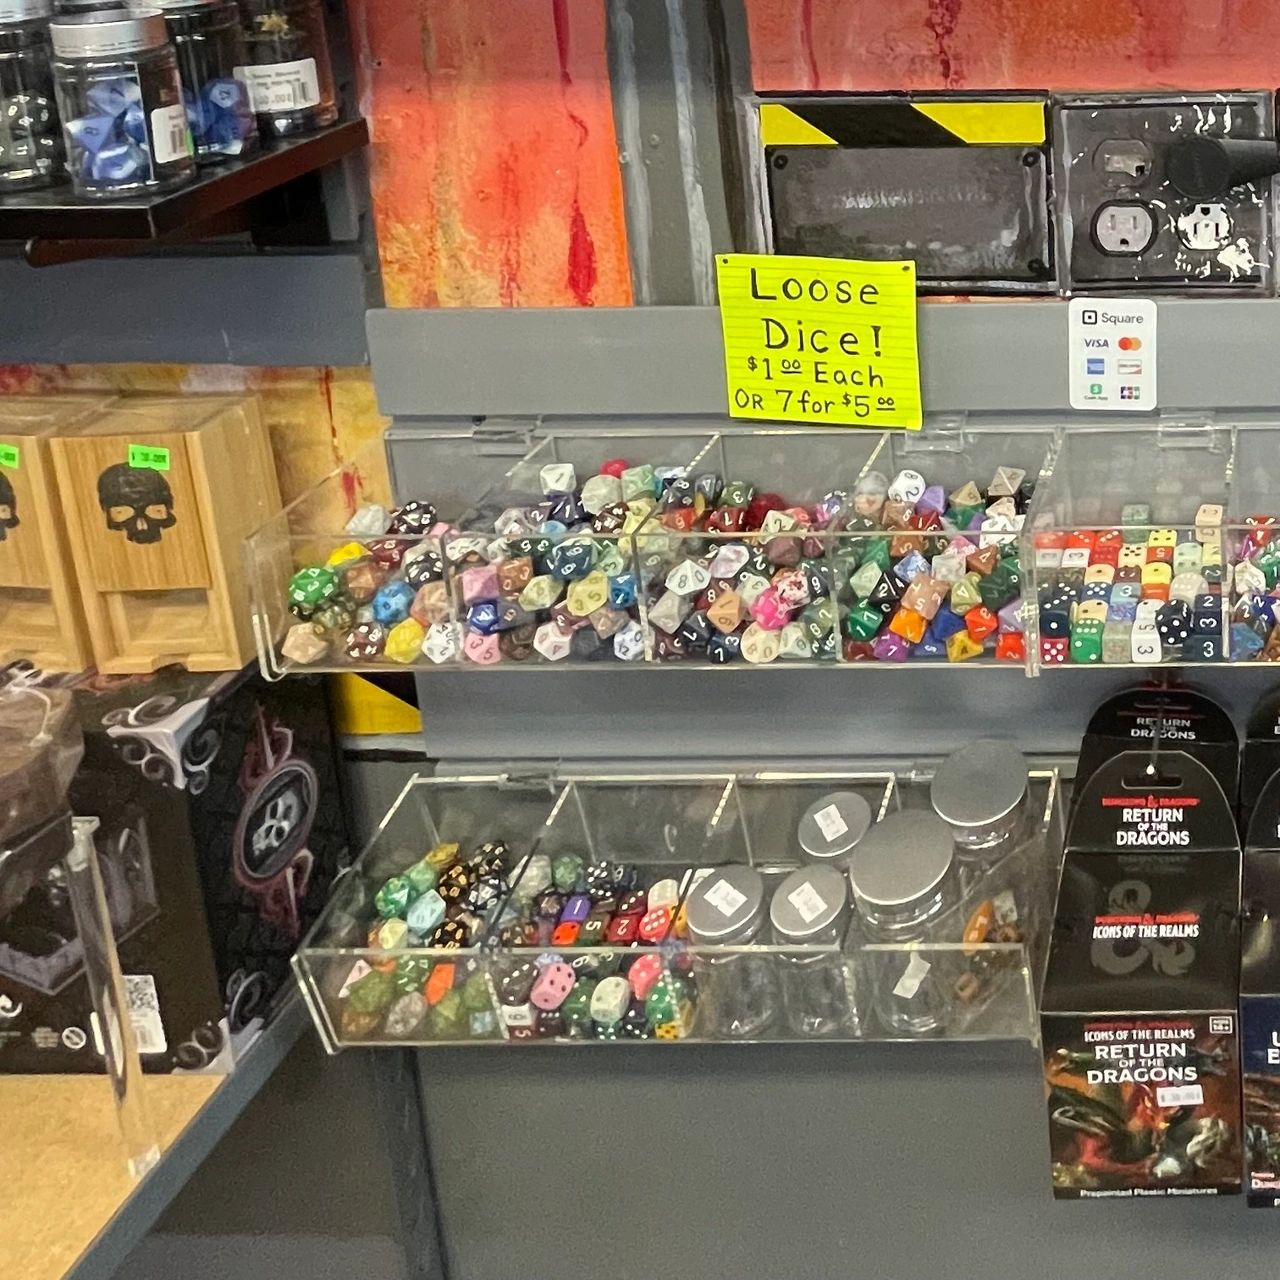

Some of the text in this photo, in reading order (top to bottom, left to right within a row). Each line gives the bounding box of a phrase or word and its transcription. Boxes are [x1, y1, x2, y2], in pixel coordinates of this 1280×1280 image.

[1101, 313, 1143, 325] Square
[761, 318, 881, 357] Dice!
[1084, 339, 1109, 348] VISA
[814, 361, 883, 387] Each
[776, 390, 793, 412] 7
[797, 390, 835, 413] for
[1123, 808, 1184, 822] RETURN
[1138, 823, 1149, 831] OF
[1116, 830, 1190, 846] DRAGONS
[1092, 923, 1199, 939] ICONS OF THE REALMS
[1084, 1028, 1195, 1042] ICONS OF THE REALMS
[1095, 1043, 1186, 1060] RETURN
[1118, 1058, 1165, 1067] OF THE
[1087, 1067, 1198, 1084] DRAGONS
